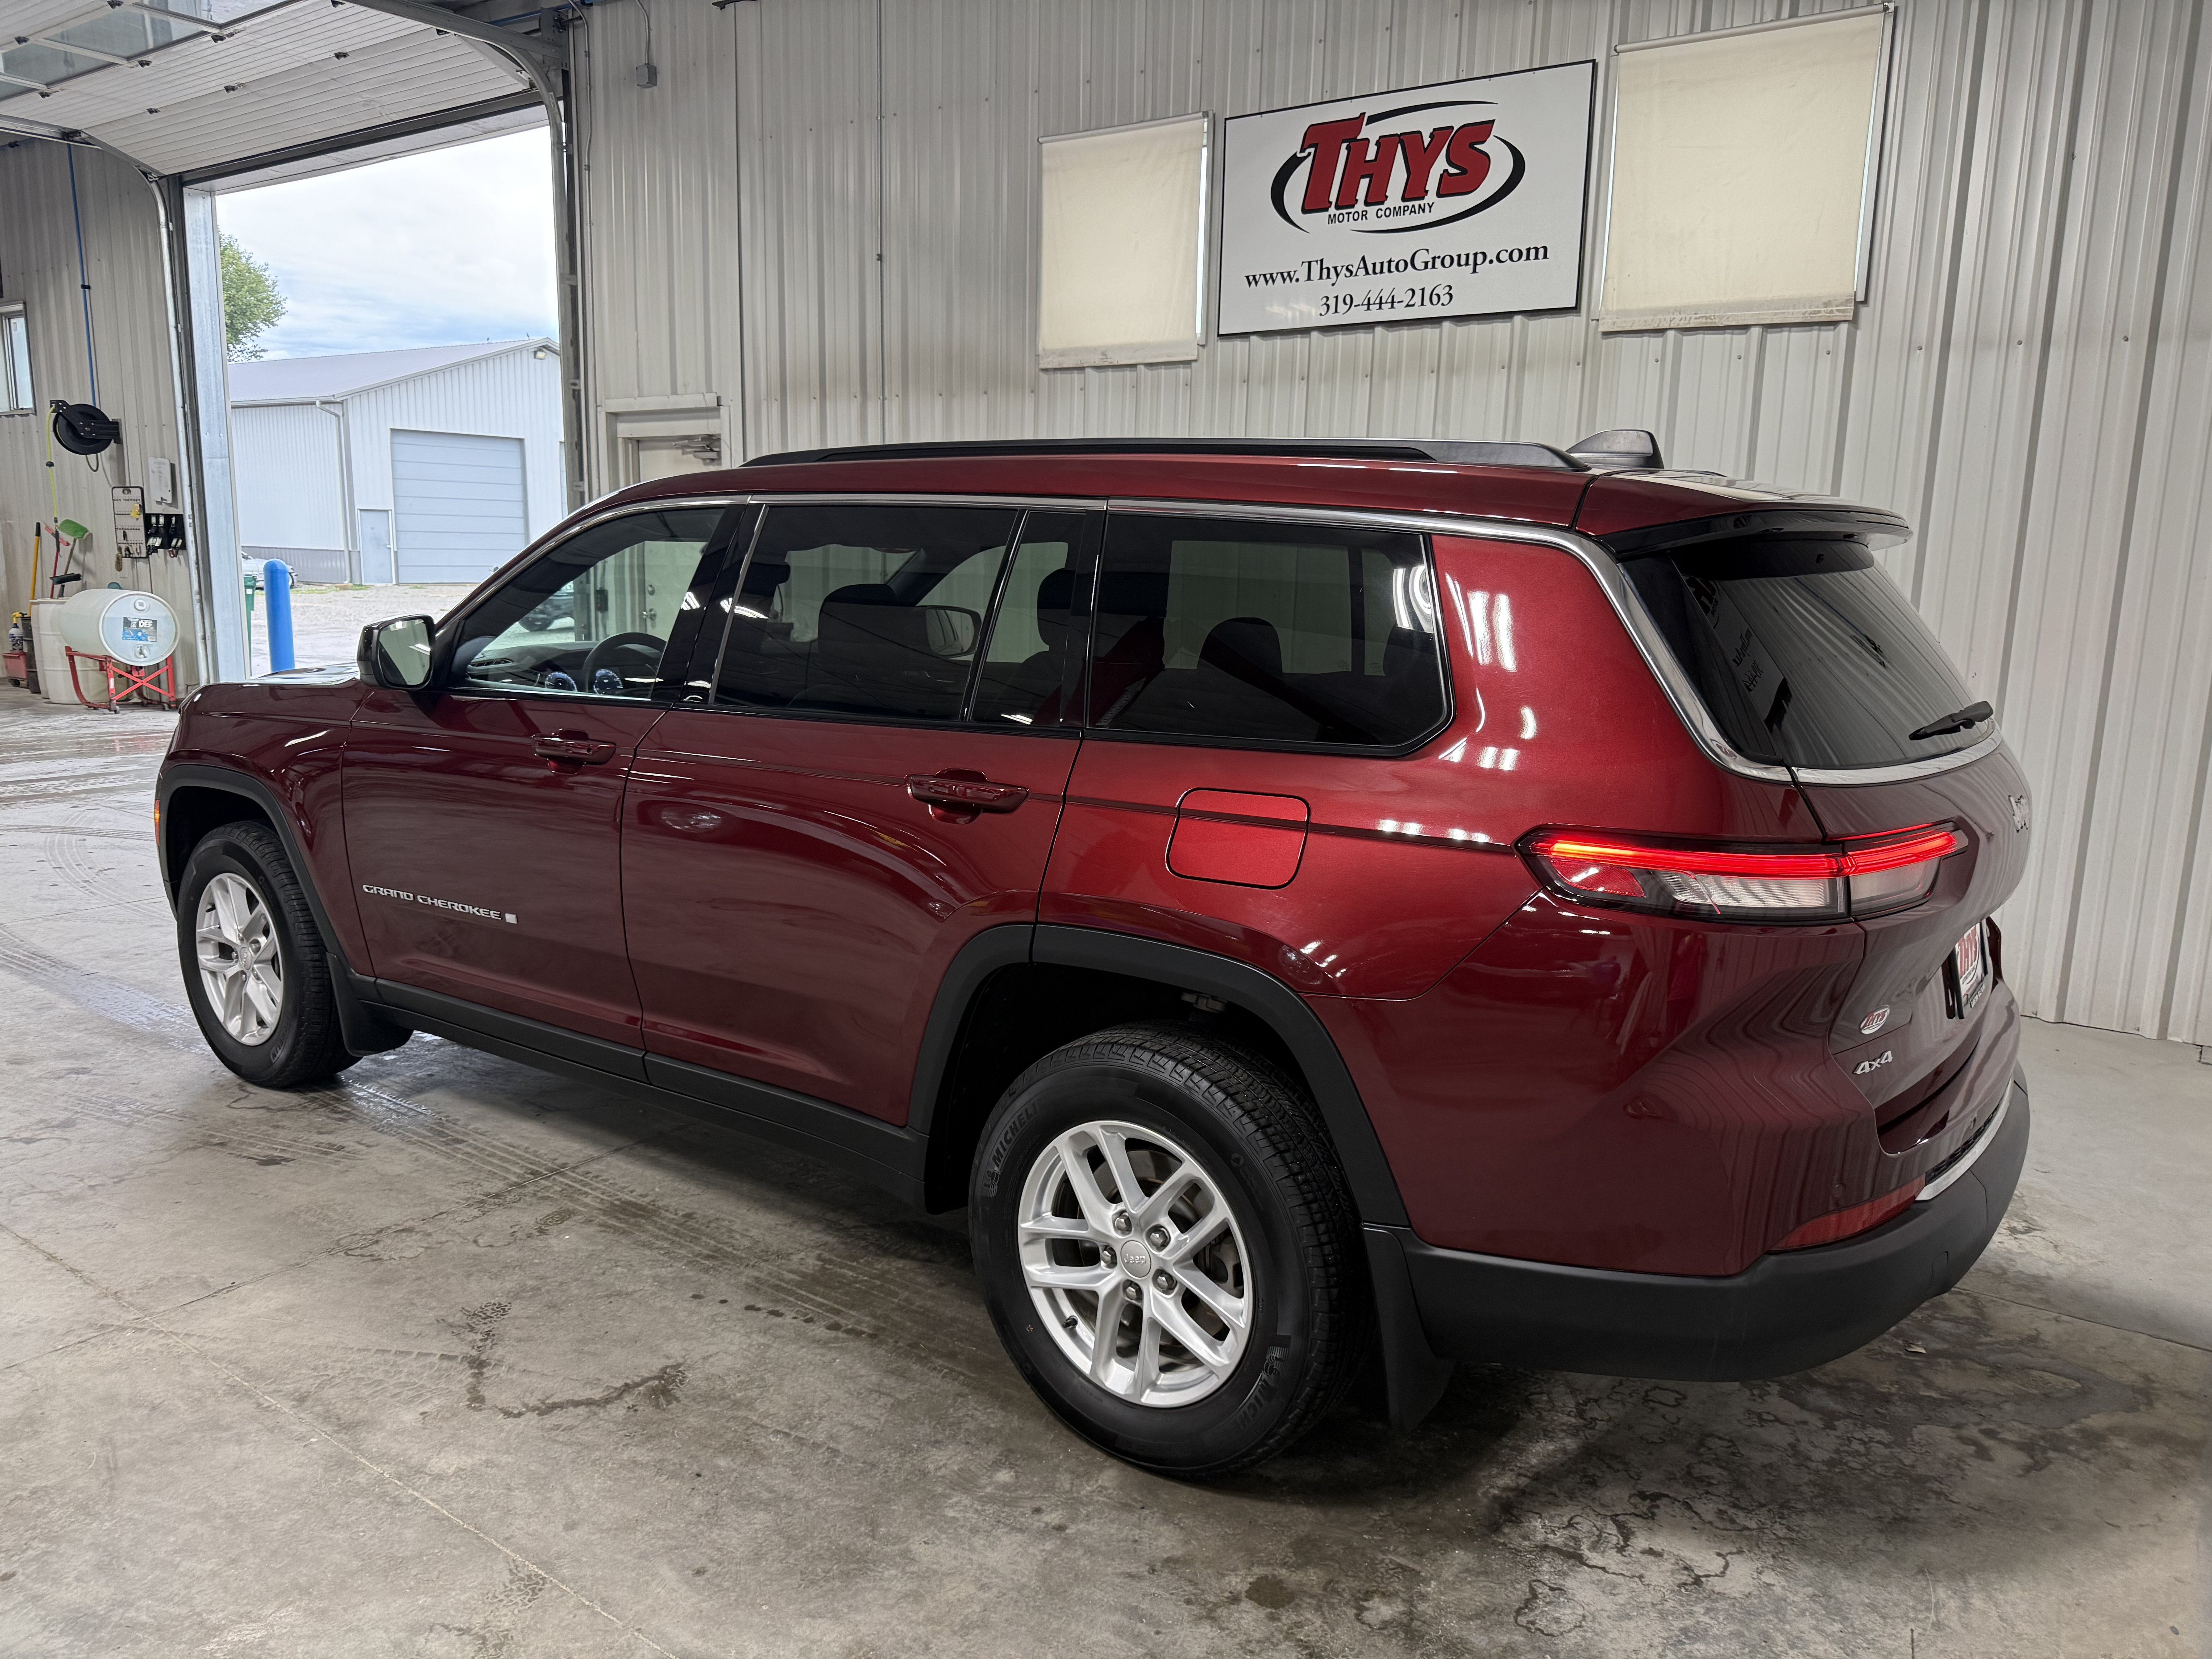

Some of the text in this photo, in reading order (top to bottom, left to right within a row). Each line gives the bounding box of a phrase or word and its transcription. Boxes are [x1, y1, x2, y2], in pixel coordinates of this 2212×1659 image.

[1300, 112, 1496, 214] THYS
[1328, 202, 1435, 225] MOTOR COMPANY
[1244, 245, 1549, 287] www.ThysAutoGroup.com
[1319, 284, 1453, 317] 319-444-2163
[362, 884, 501, 920] GRAND CHEROKEE
[1853, 1050, 1893, 1075] 4x4
[1123, 1253, 1146, 1266] Jeep
